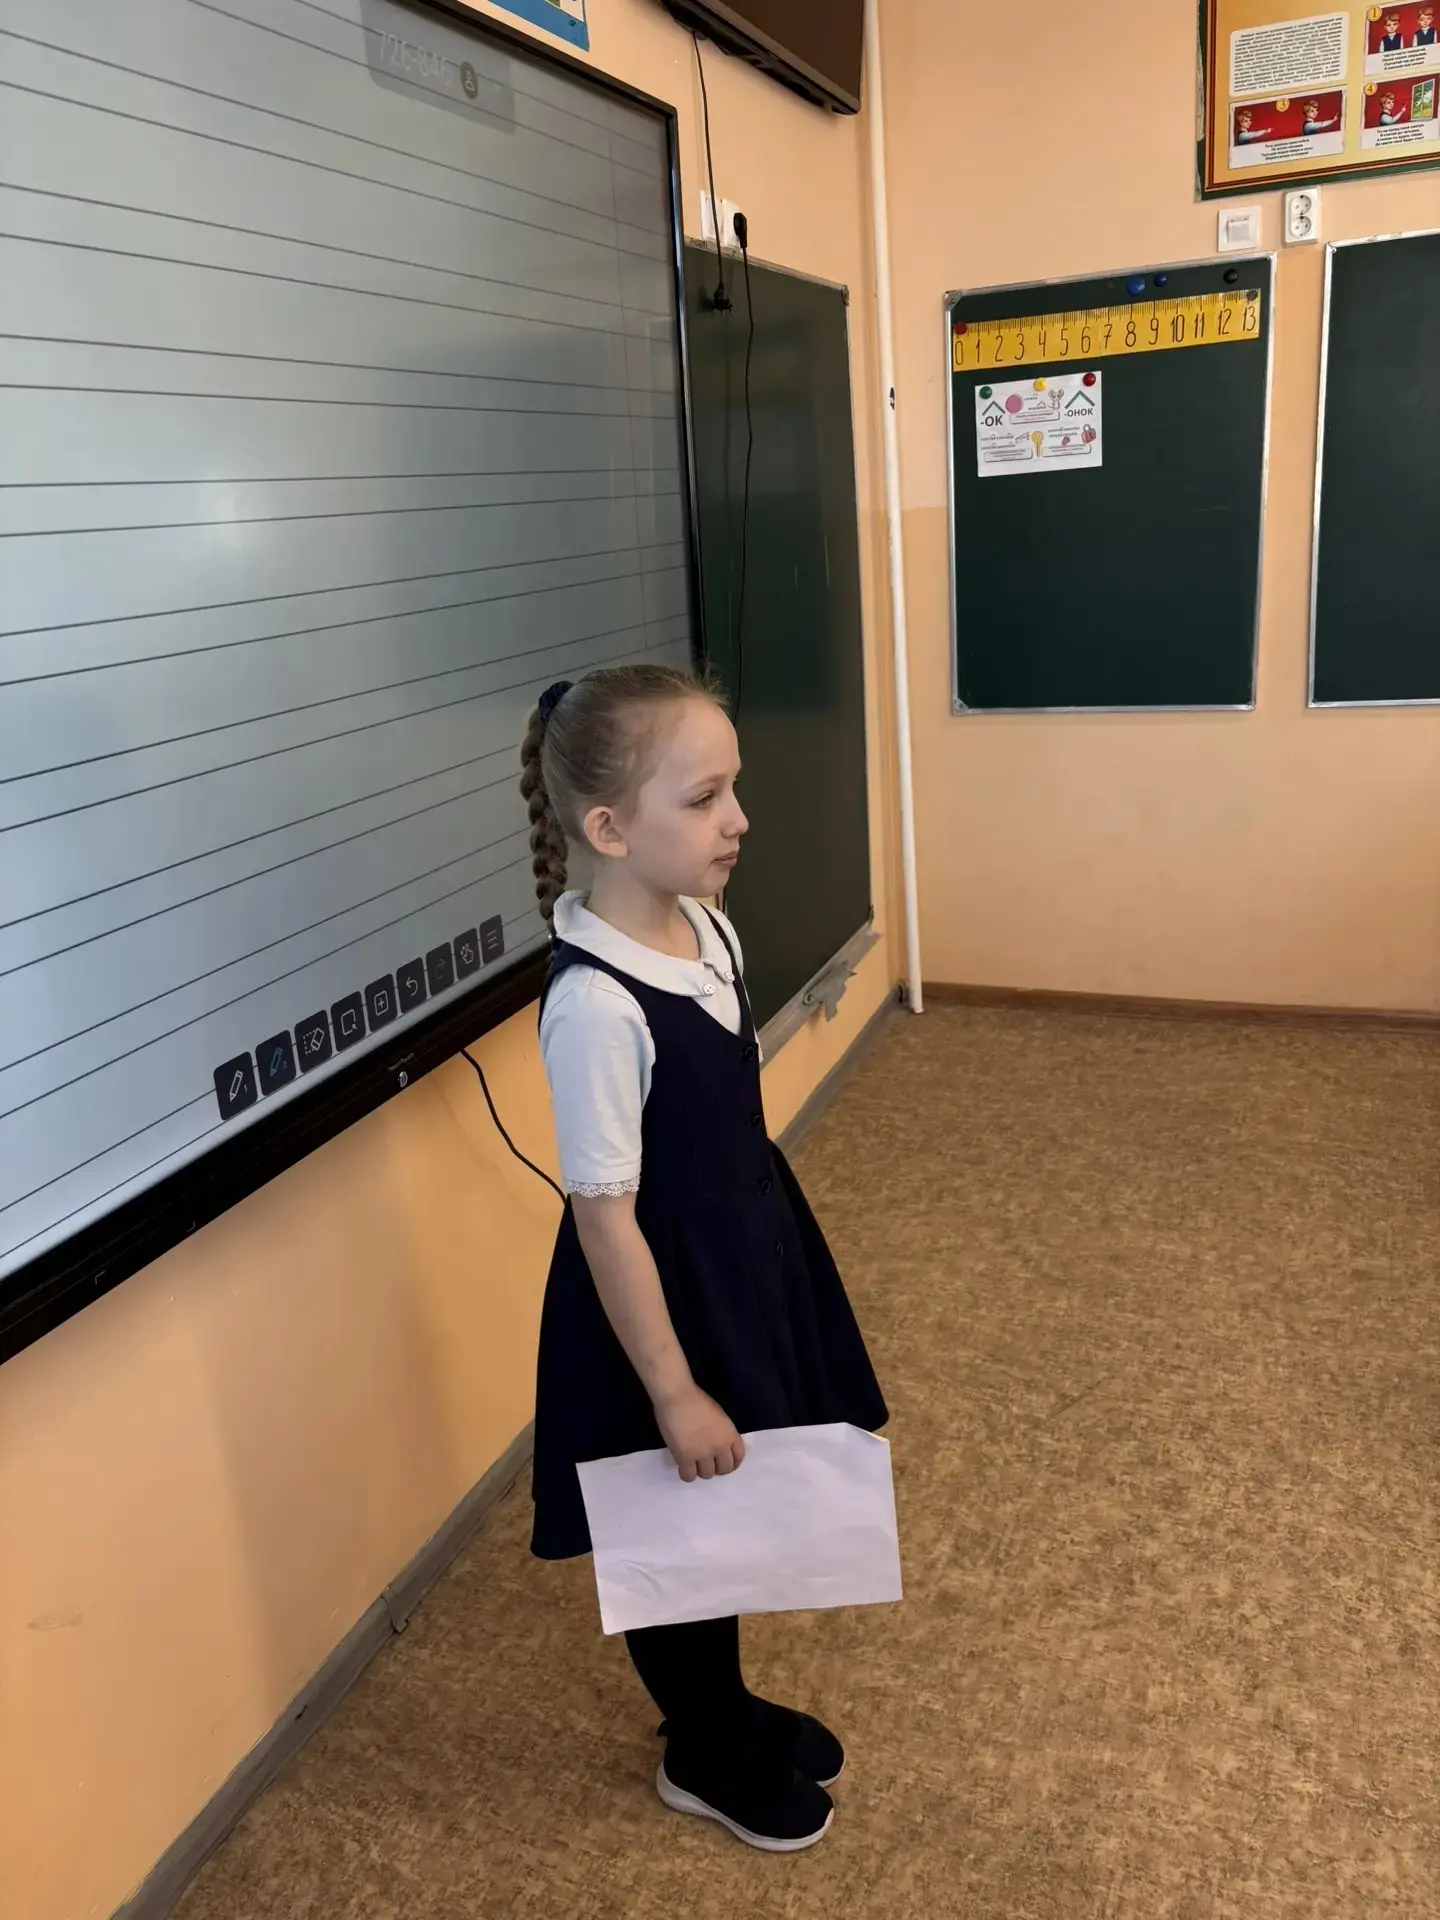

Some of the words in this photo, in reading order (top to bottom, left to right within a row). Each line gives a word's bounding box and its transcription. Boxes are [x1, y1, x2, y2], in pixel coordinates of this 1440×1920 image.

[1366, 84, 1373, 94] 4
[1280, 100, 1286, 109] 3
[955, 340, 964, 365] 0
[975, 339, 981, 363] 1
[994, 336, 1003, 362] 2
[1015, 334, 1025, 360] 3
[1038, 330, 1047, 357] 4
[1060, 328, 1069, 356] 5
[1081, 326, 1091, 354] 6
[1103, 324, 1113, 350] 7
[1124, 321, 1137, 348] 8
[1149, 317, 1159, 345] 9
[1171, 314, 1185, 343] 10
[1193, 313, 1206, 338] 11
[1217, 309, 1232, 335] 12
[1242, 305, 1256, 332] 13
[1064, 407, 1094, 417] -ОНОК
[980, 415, 1003, 427] -ОК
